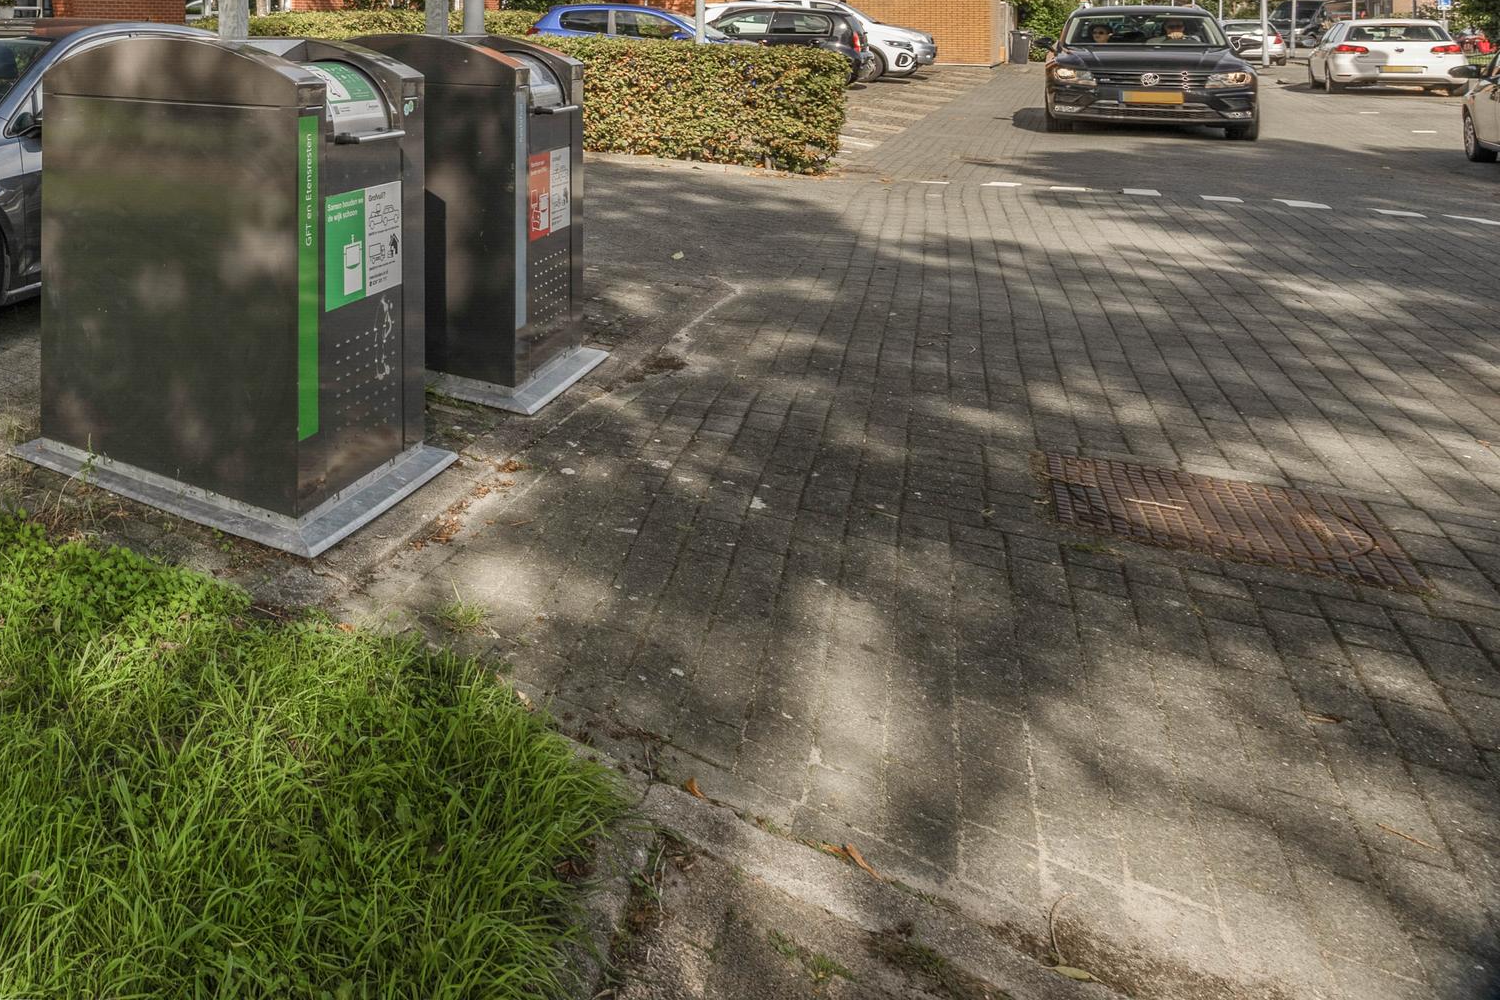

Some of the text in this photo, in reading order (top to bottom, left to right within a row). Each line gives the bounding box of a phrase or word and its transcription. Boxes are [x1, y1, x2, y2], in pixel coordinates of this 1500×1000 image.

[305, 133, 313, 247] GFT en Etensresten
